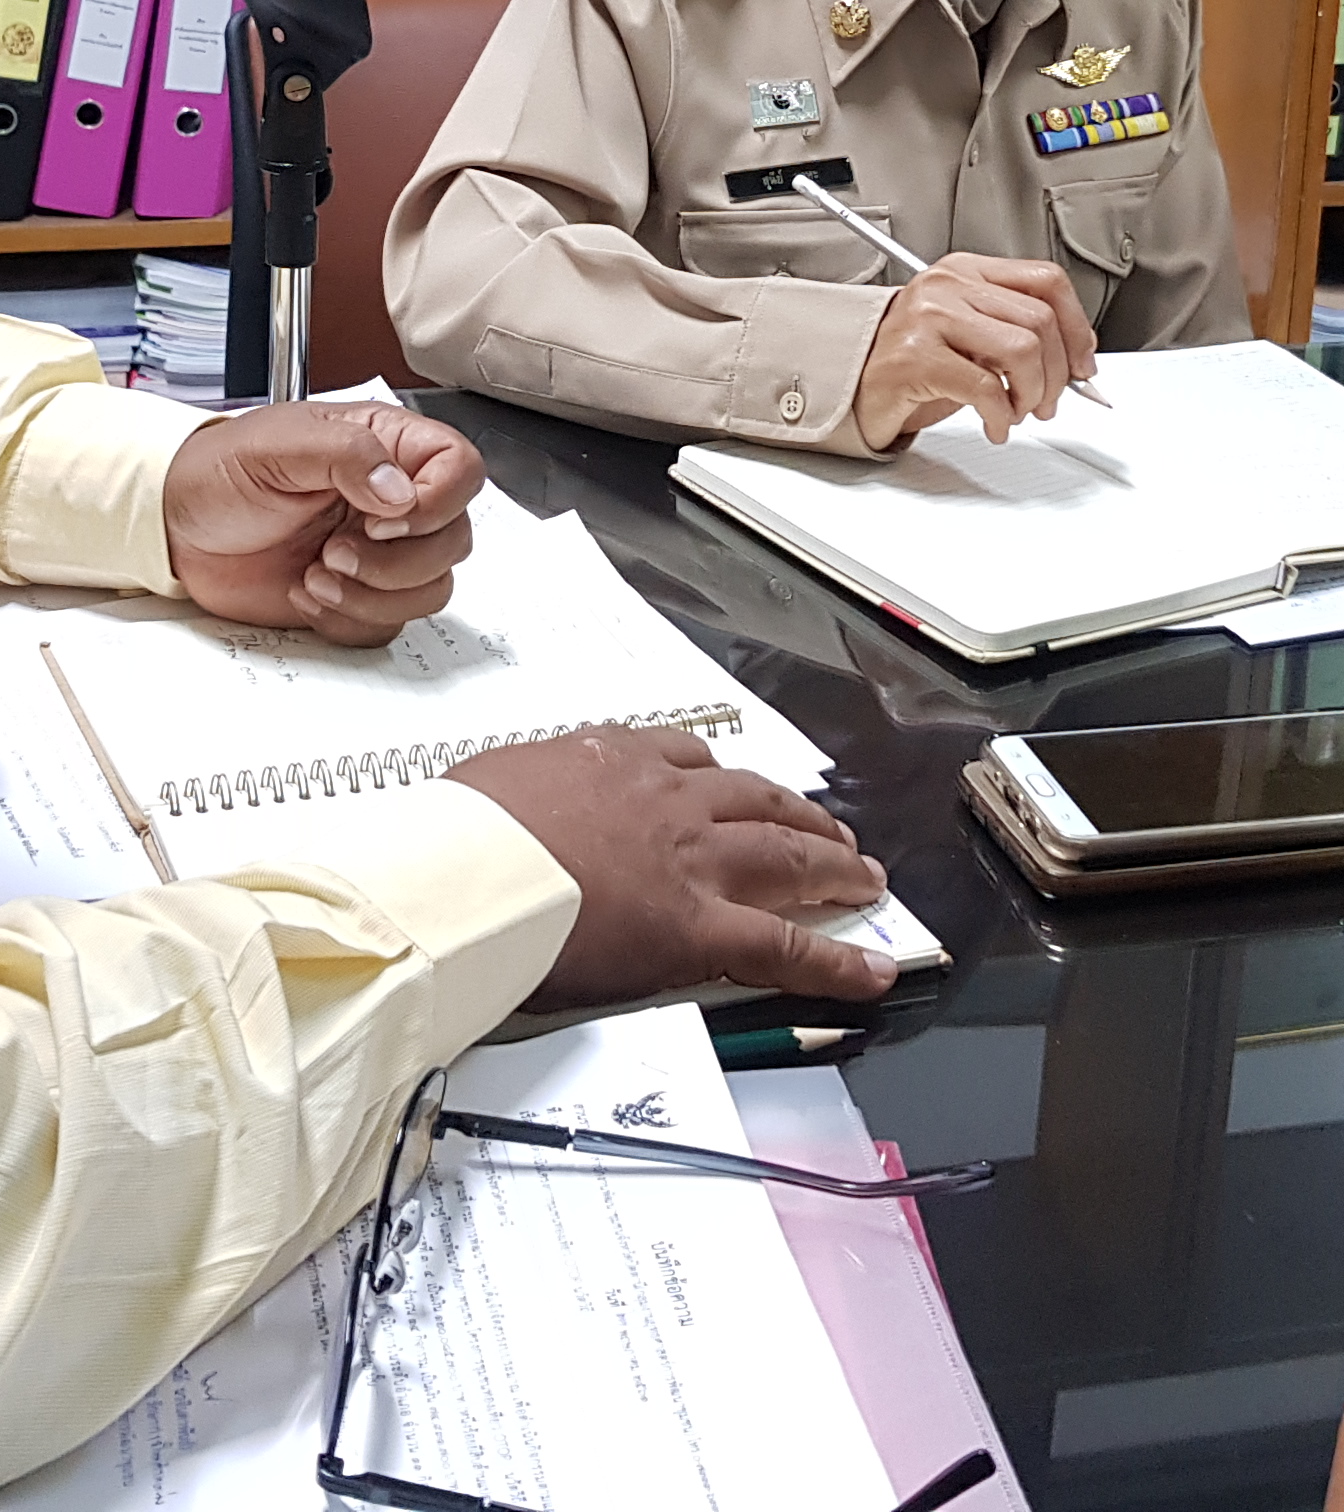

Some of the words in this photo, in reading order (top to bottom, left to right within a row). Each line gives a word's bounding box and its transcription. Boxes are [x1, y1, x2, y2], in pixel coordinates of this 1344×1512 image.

[651, 1238, 699, 1328] บันทึกข้อความ
